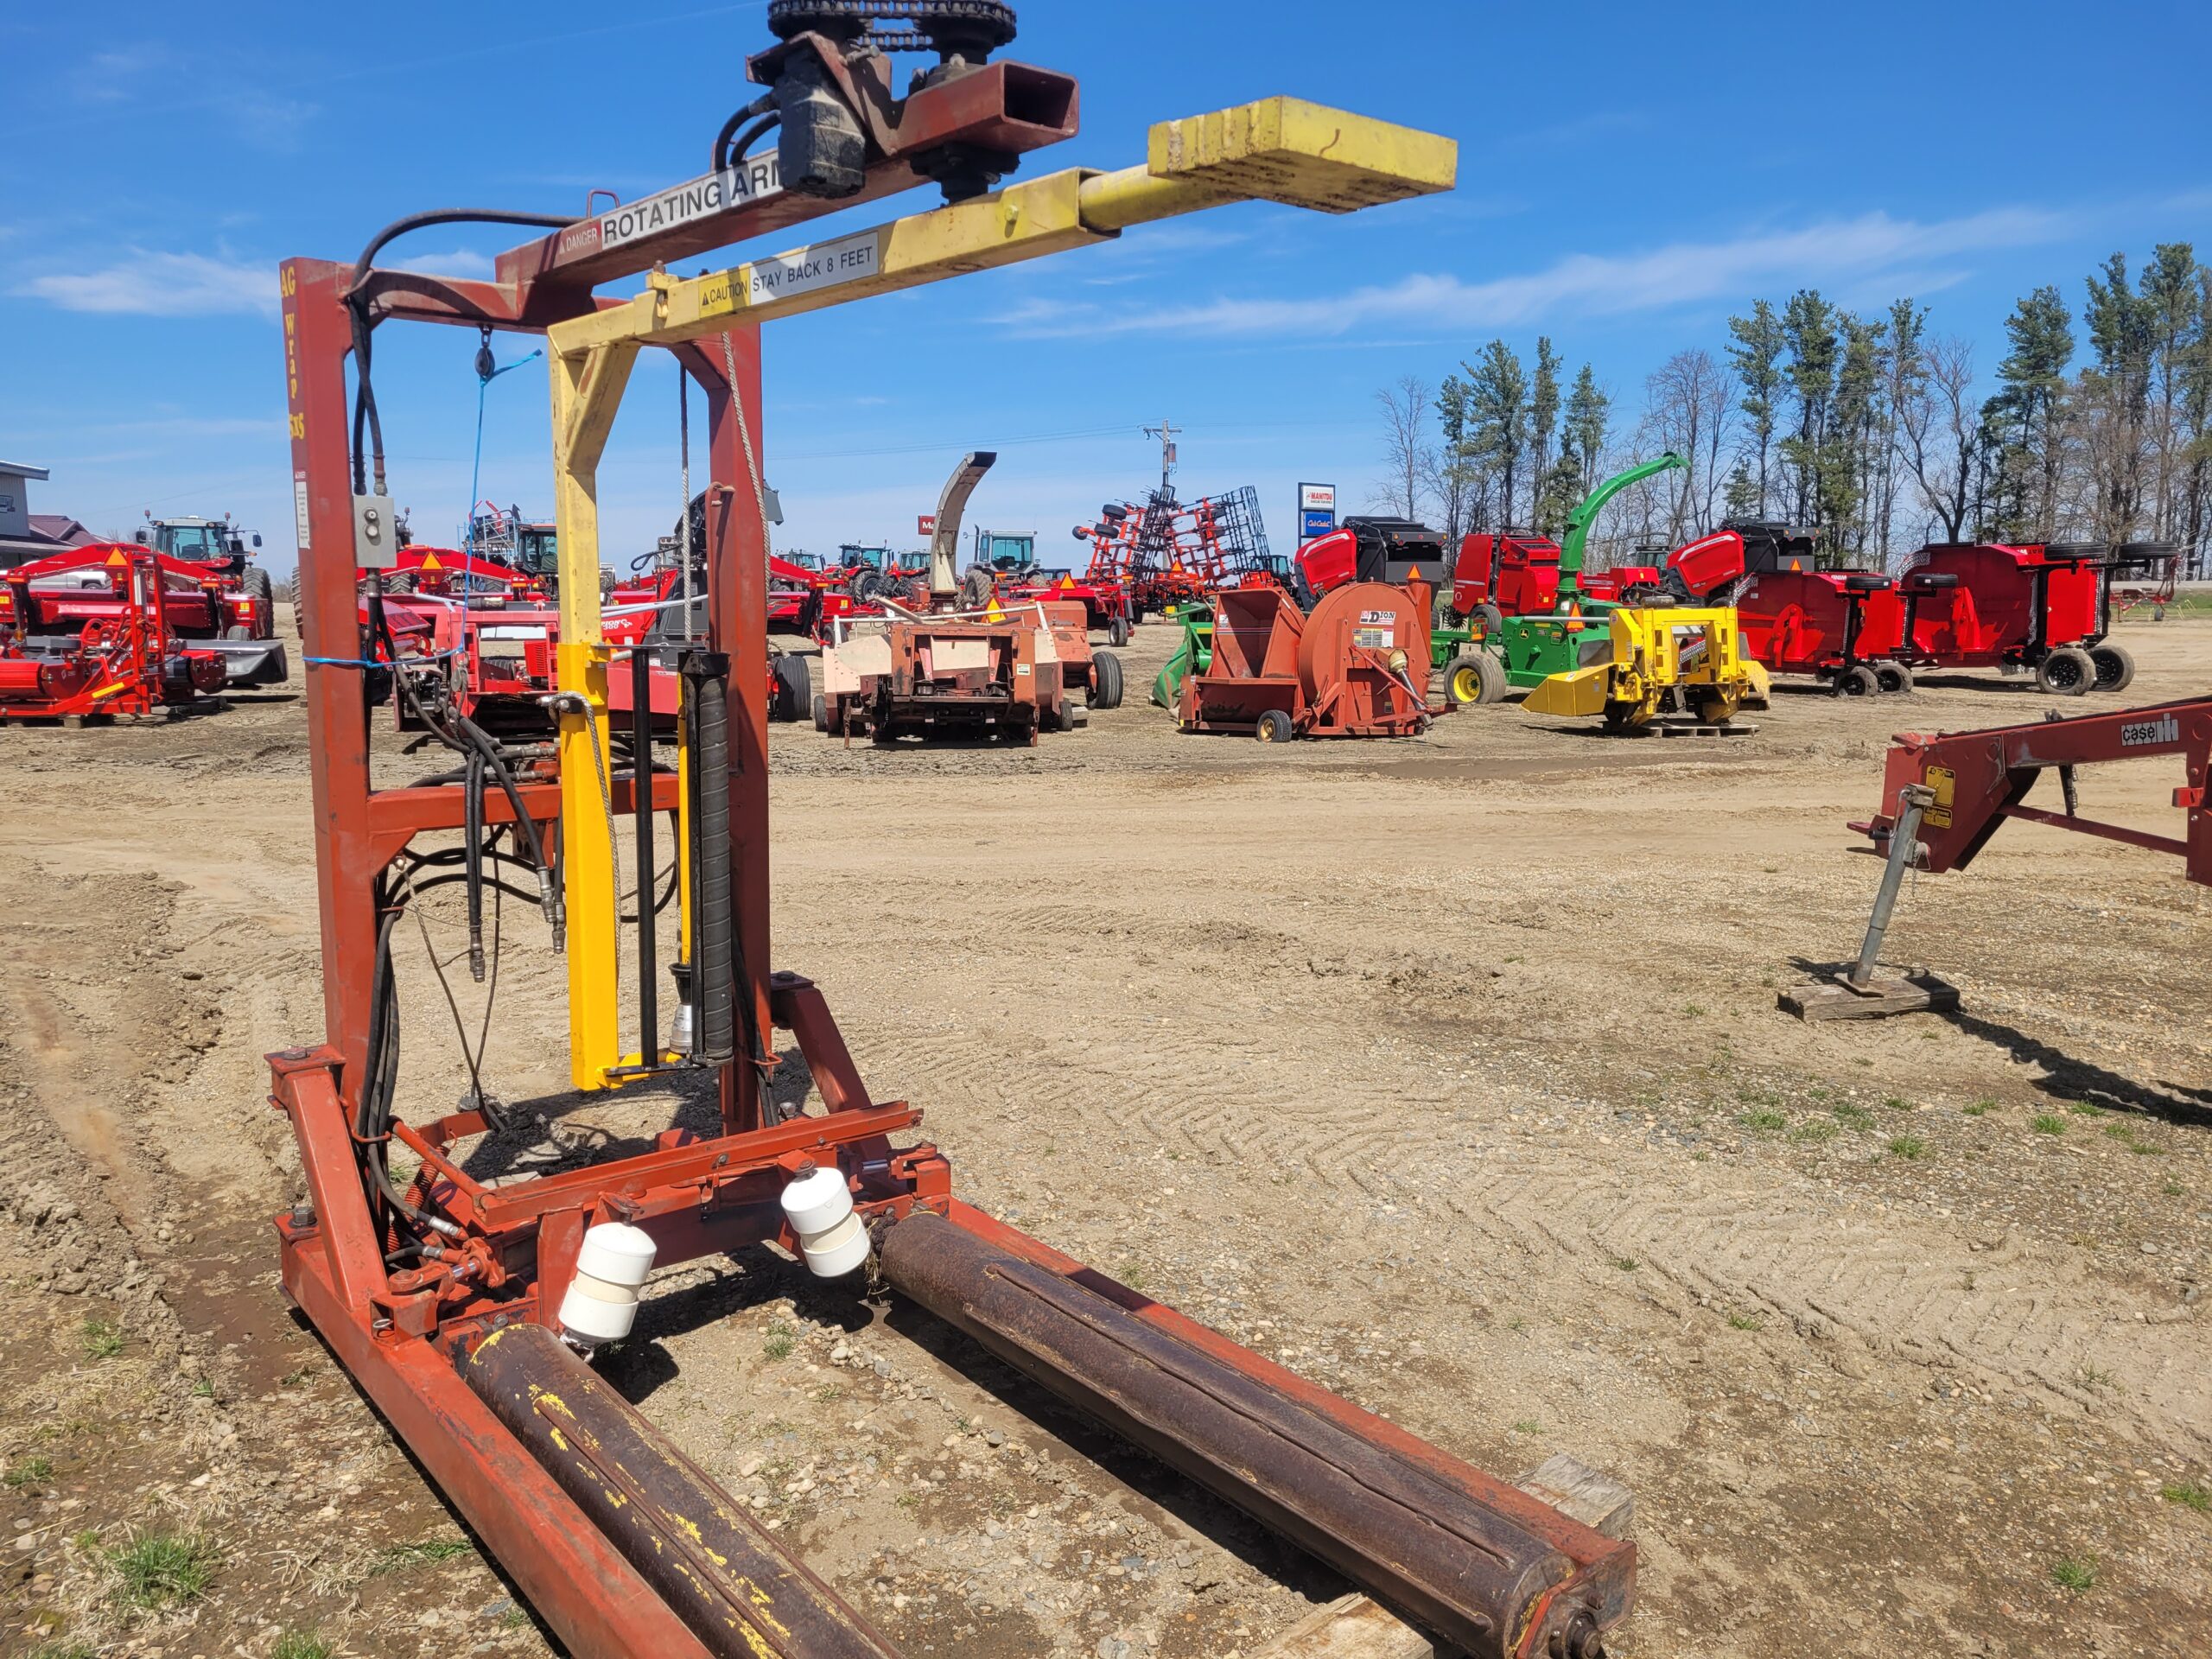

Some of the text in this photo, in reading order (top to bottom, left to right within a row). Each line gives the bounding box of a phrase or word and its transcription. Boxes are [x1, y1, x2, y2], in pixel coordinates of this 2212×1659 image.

[566, 227, 598, 251] DANGER
[603, 181, 721, 245] ROTATING
[281, 266, 296, 298] AG
[709, 246, 873, 303] CAUTION STAY BACK 8 FEET
[1310, 492, 1333, 500] MANITOU
[1369, 611, 1395, 623] DION
